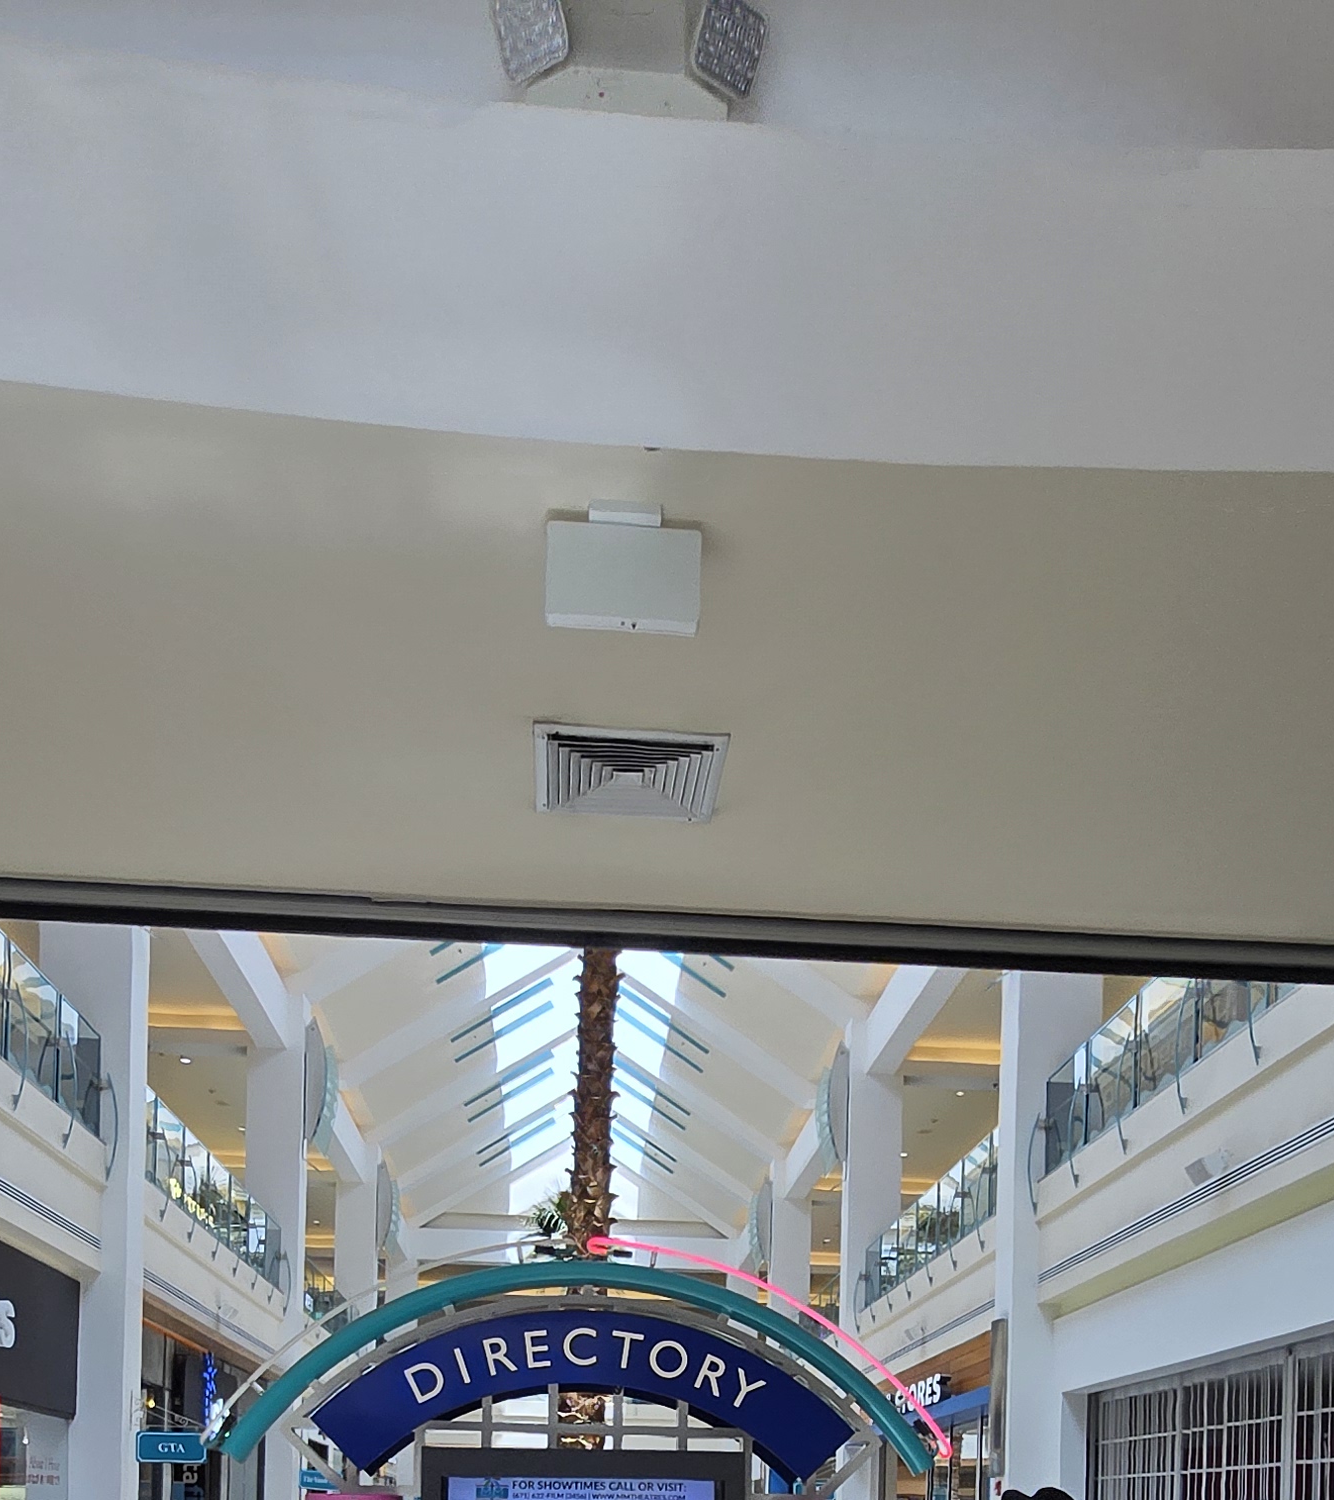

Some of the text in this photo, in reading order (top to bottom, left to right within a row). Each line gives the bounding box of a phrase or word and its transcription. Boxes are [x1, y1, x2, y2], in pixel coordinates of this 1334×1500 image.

[403, 1327, 767, 1409] DIRECTORY
[158, 1443, 186, 1453] GTA
[512, 1481, 687, 1492] FOR SHOWTIMES CALL OR VISIT:
